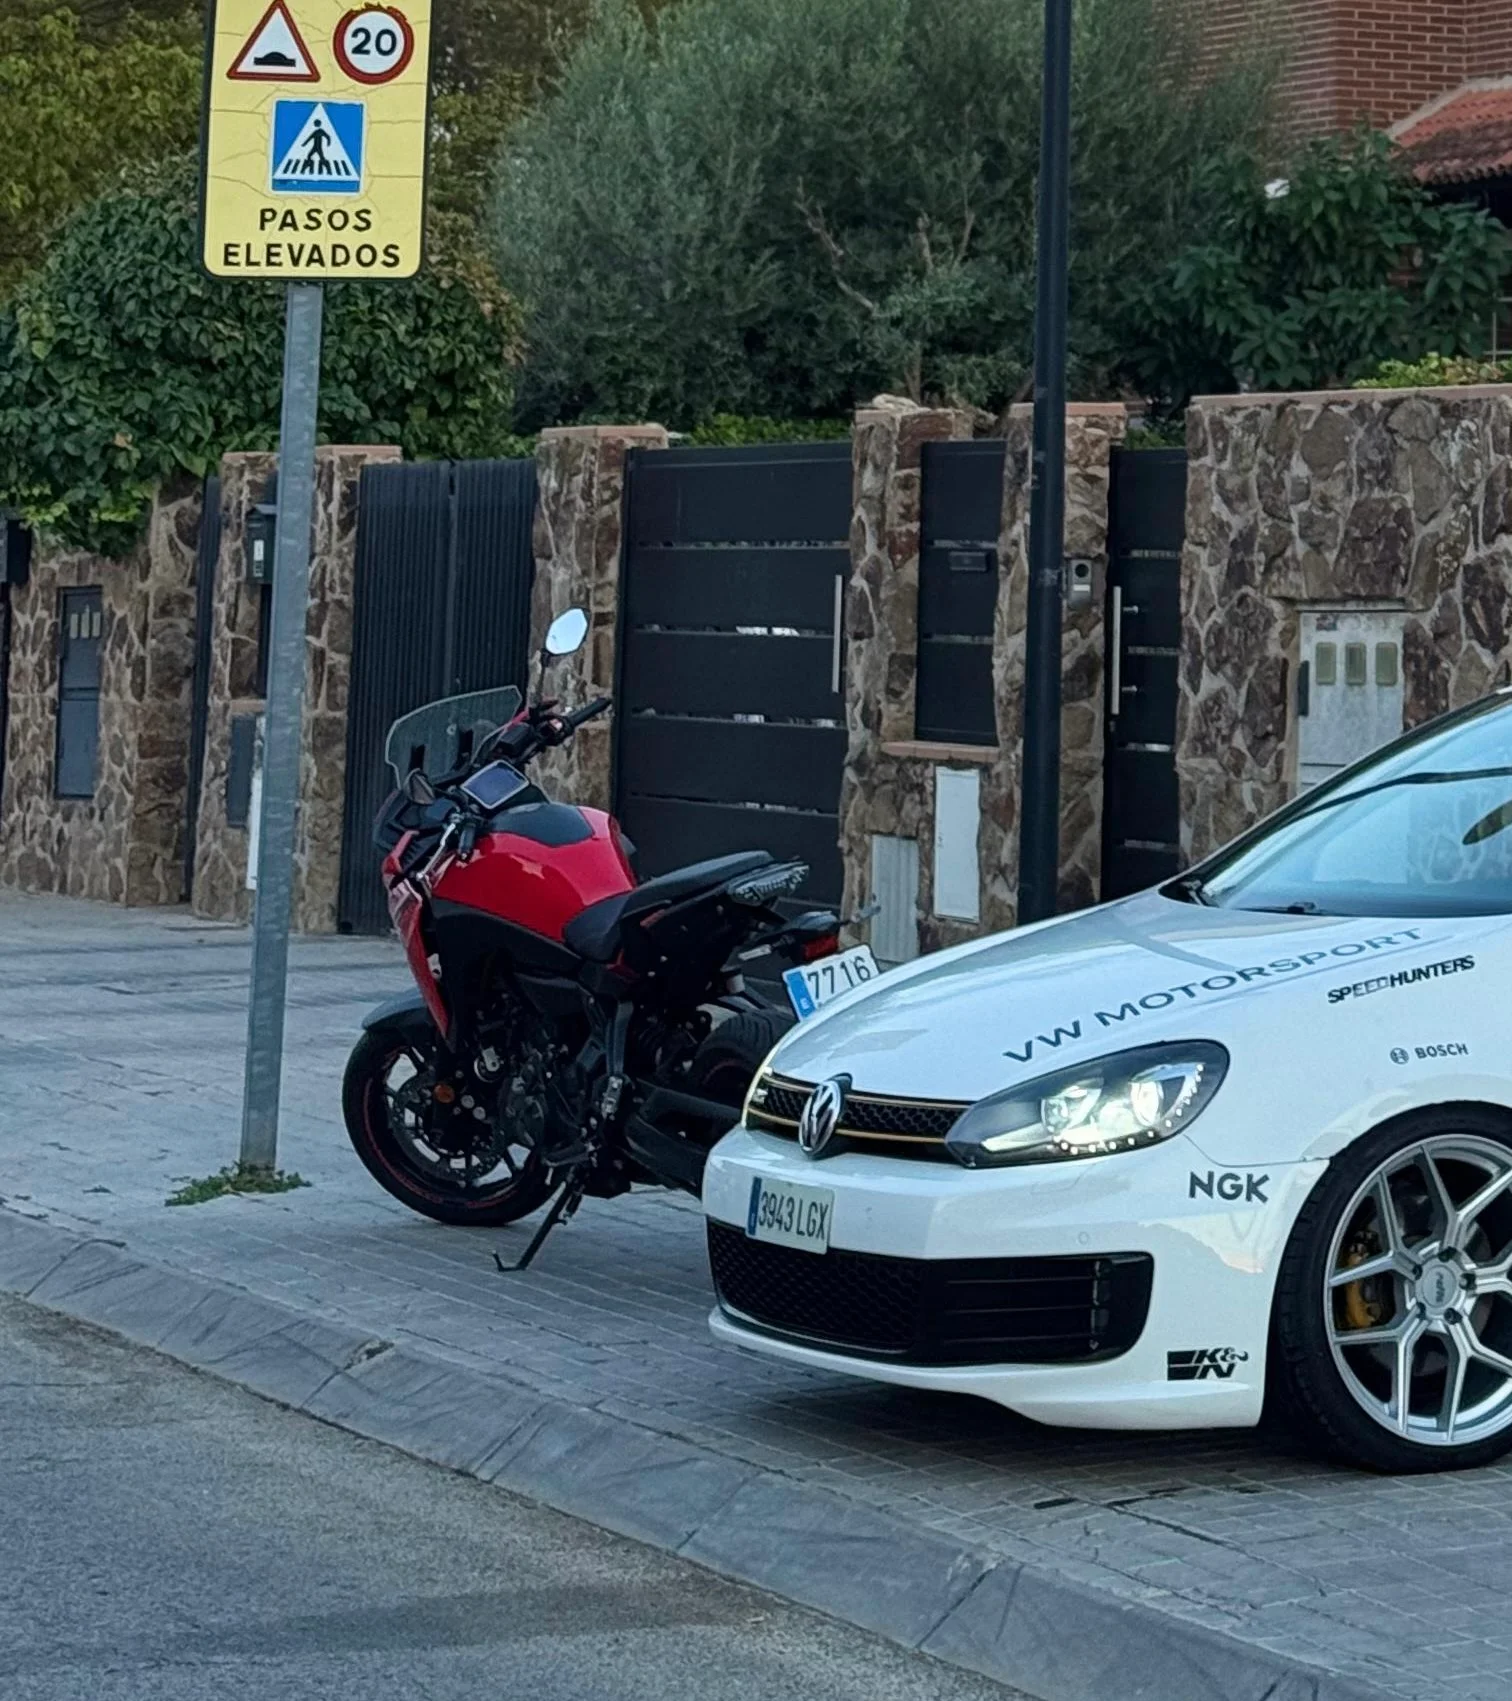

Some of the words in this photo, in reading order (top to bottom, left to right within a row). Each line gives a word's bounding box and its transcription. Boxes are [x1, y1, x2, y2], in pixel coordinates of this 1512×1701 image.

[351, 27, 397, 57] 20
[259, 207, 373, 232] PASOS
[223, 242, 400, 268] ELEVADOS
[807, 956, 870, 1000] 7716
[1327, 955, 1475, 1004] SPEEDHUNTERS
[1003, 1019, 1082, 1063] VW
[1095, 927, 1424, 1027] MOTORSPORT
[1415, 1043, 1469, 1059] BOSCH
[1188, 1171, 1270, 1204] NGK
[758, 1190, 795, 1232] 3943
[796, 1198, 829, 1240] LGX
[1187, 1347, 1249, 1380] K&N
